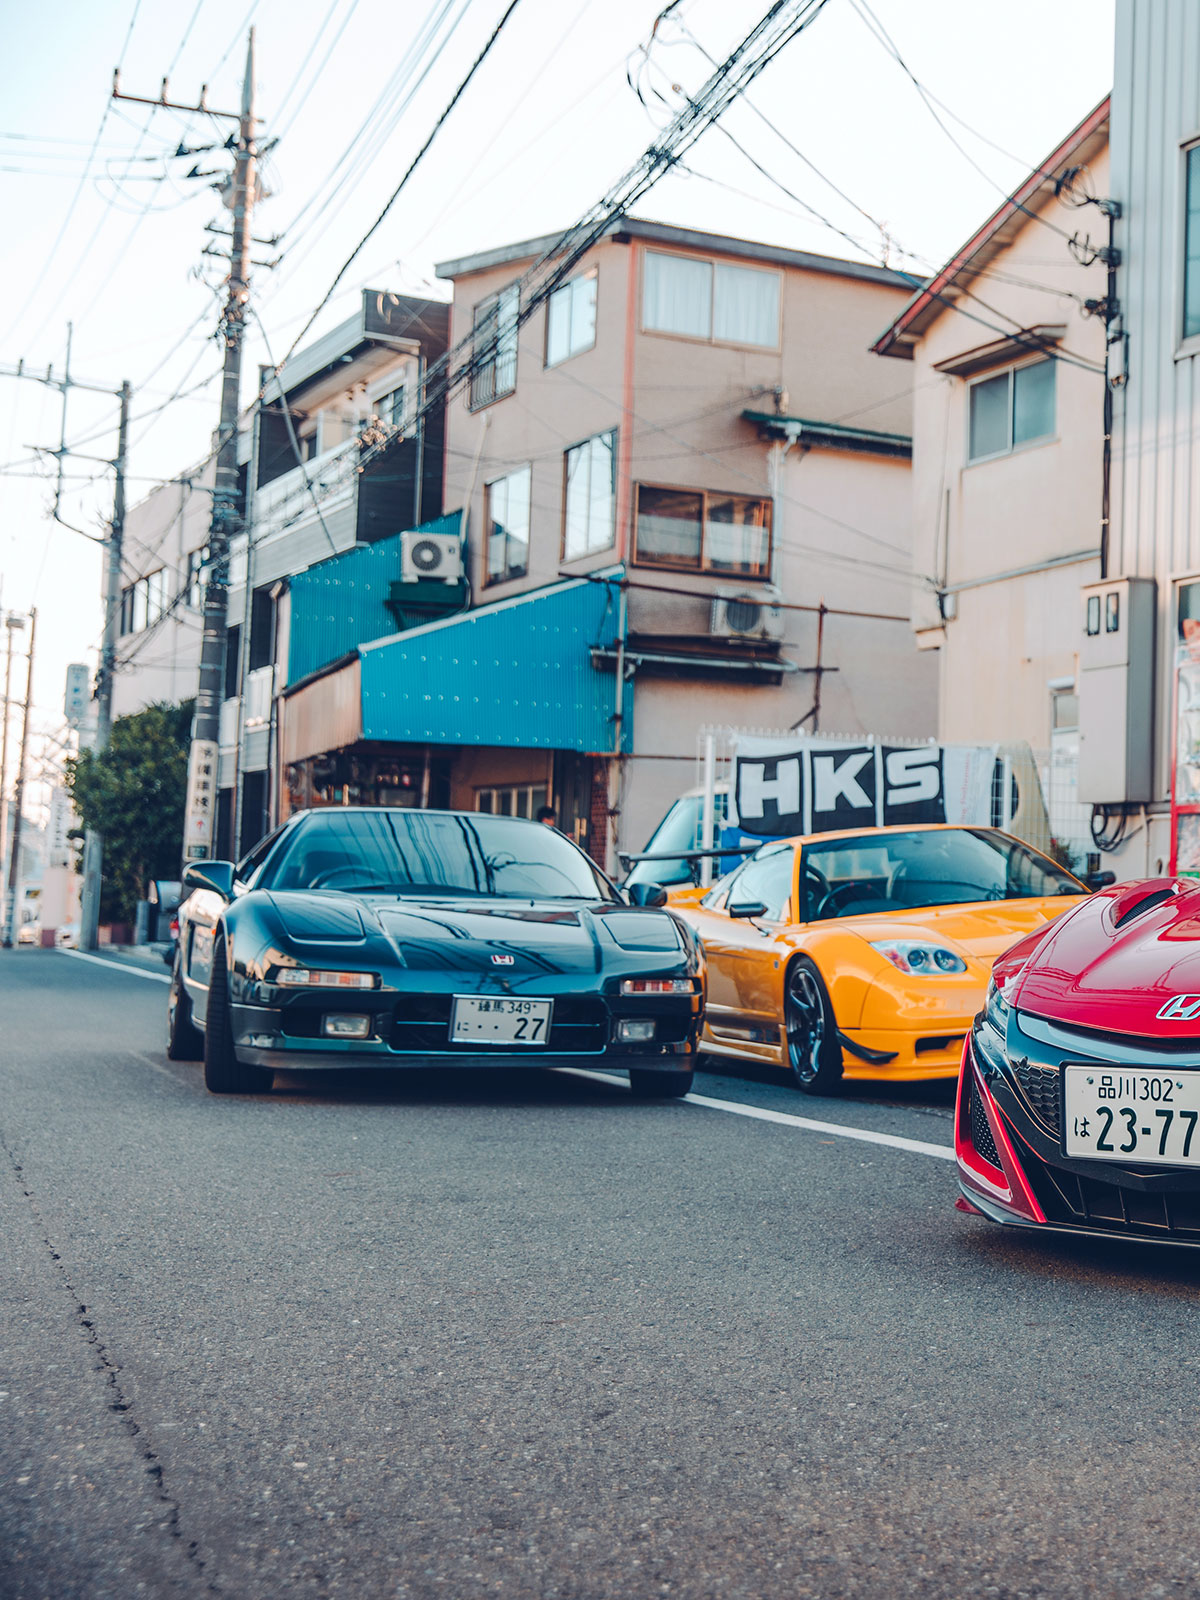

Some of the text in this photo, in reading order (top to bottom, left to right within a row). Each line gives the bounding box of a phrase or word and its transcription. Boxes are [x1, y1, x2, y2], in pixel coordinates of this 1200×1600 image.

[738, 751, 941, 818] HKS
[1098, 1075, 1174, 1102] 品川302
[1074, 1106, 1199, 1157] は 23-77
